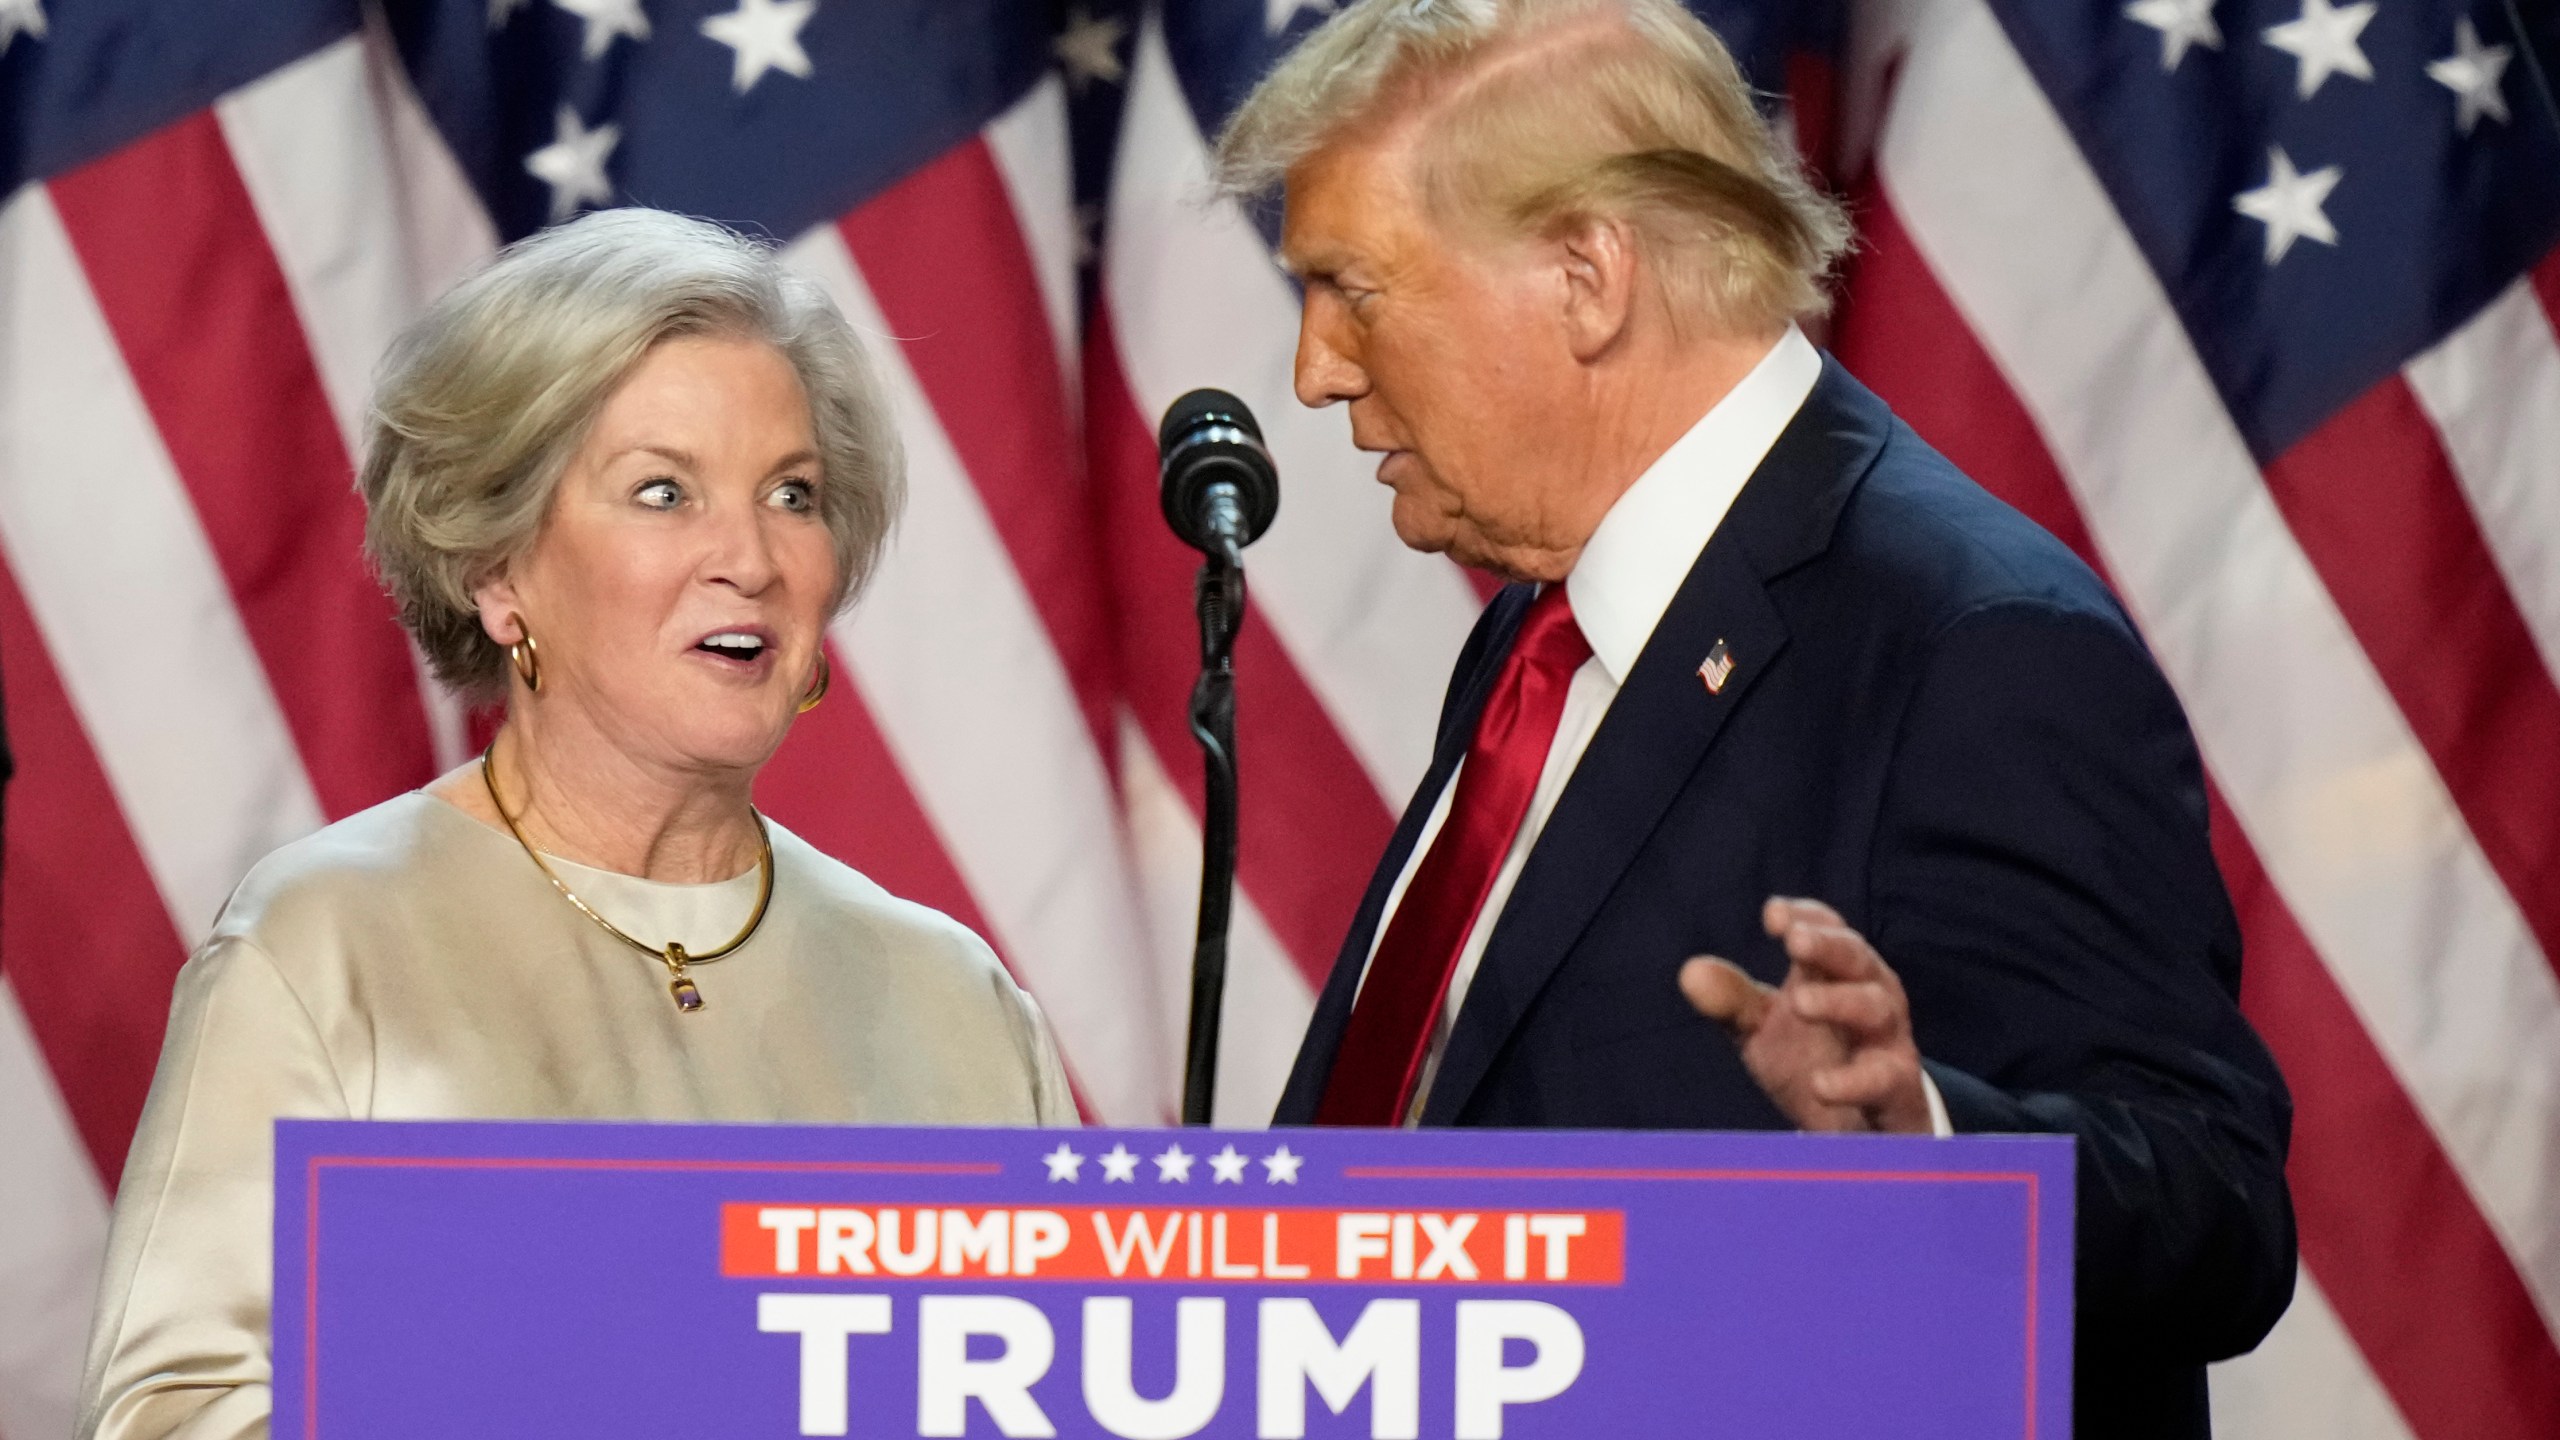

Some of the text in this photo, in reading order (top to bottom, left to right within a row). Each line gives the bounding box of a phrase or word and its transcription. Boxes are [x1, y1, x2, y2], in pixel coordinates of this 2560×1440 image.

[759, 1208, 1586, 1280] TRUMP WILL FIX IT
[757, 1293, 1585, 1440] TRUMP
